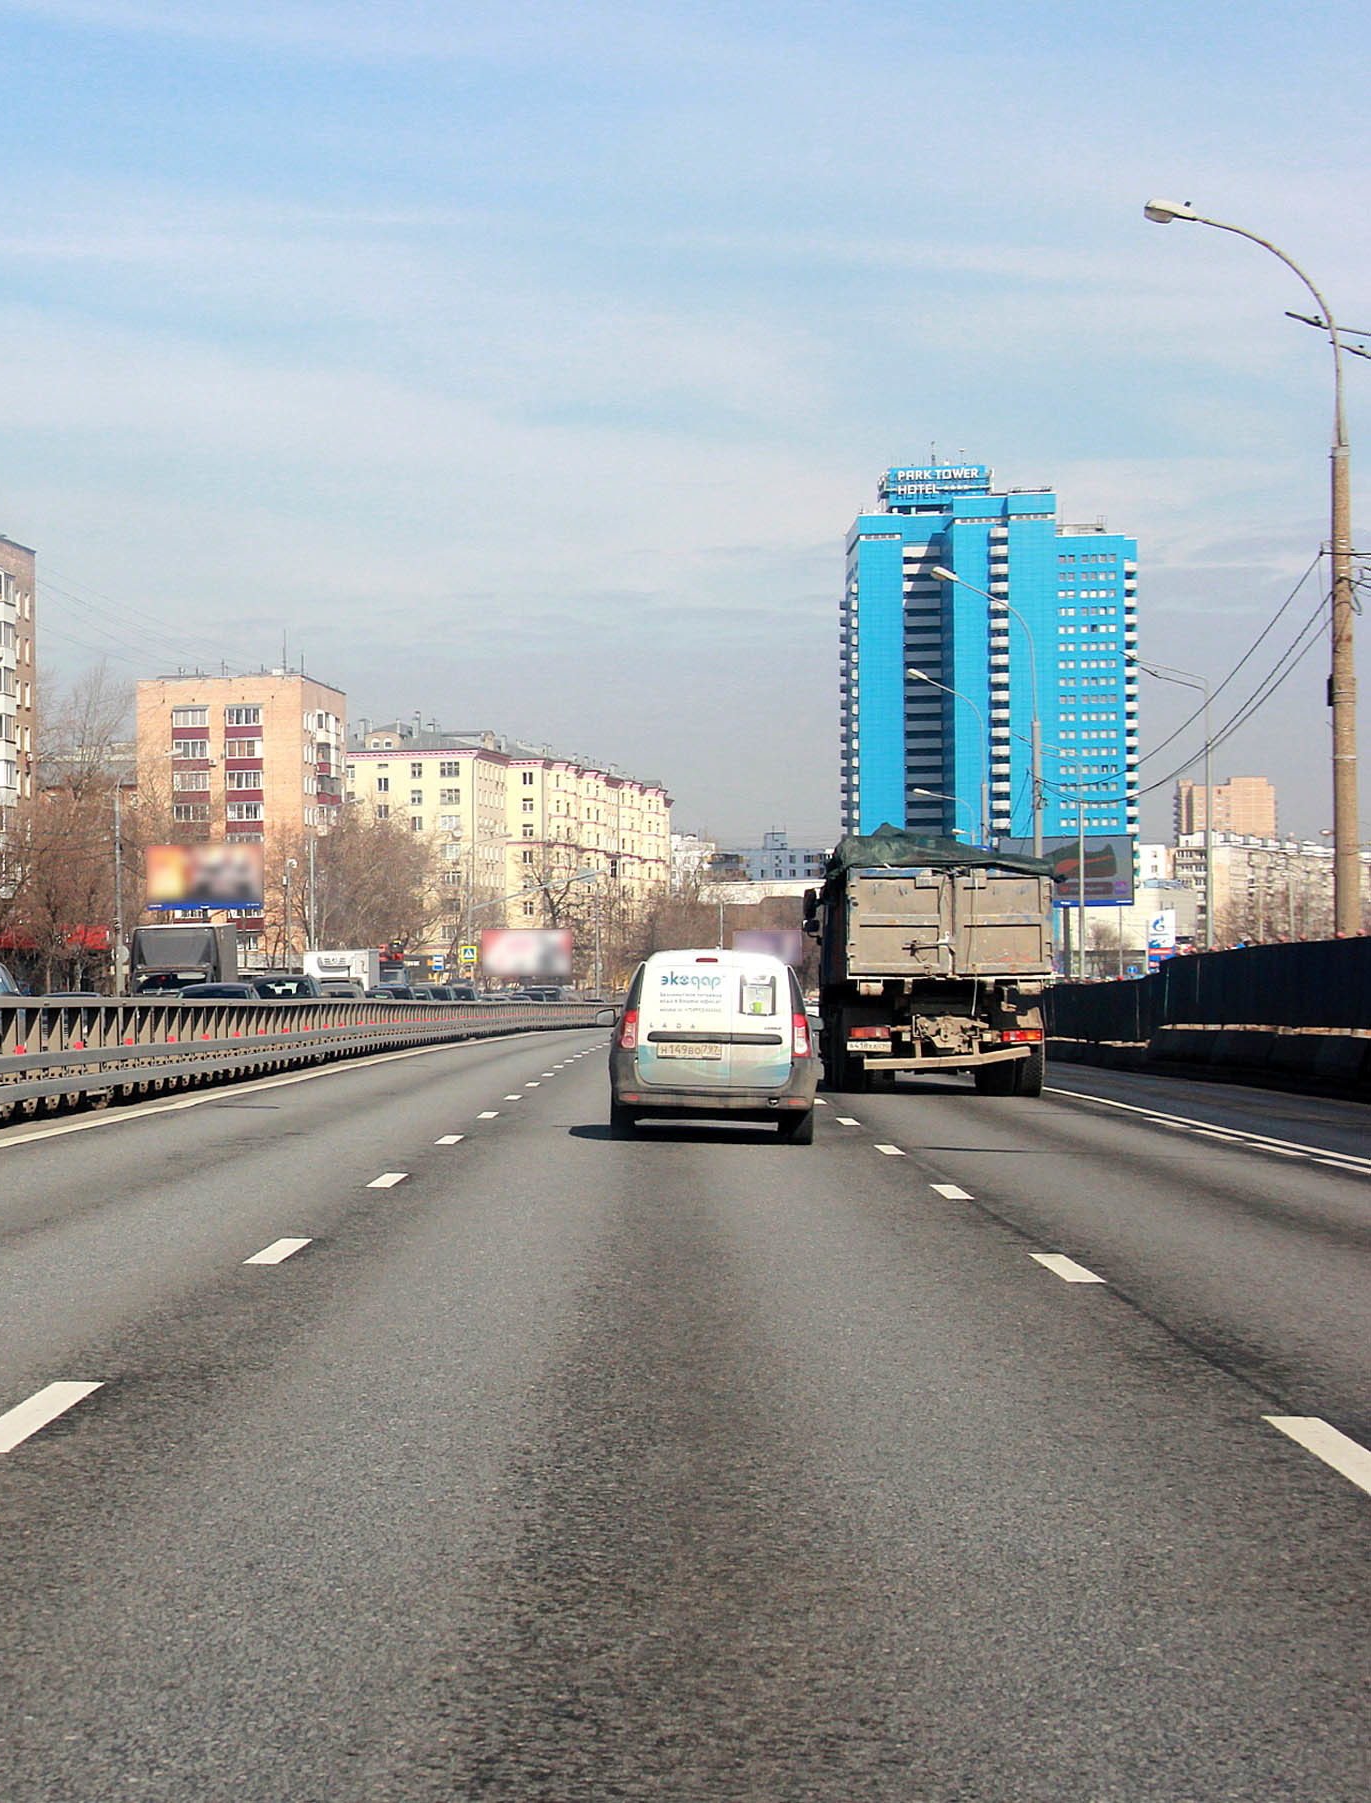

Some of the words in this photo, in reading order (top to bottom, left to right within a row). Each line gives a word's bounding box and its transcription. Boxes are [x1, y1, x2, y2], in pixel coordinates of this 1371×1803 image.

[897, 470, 933, 480] PARK
[935, 467, 979, 479] TOWER
[897, 483, 940, 495] HOTEL
